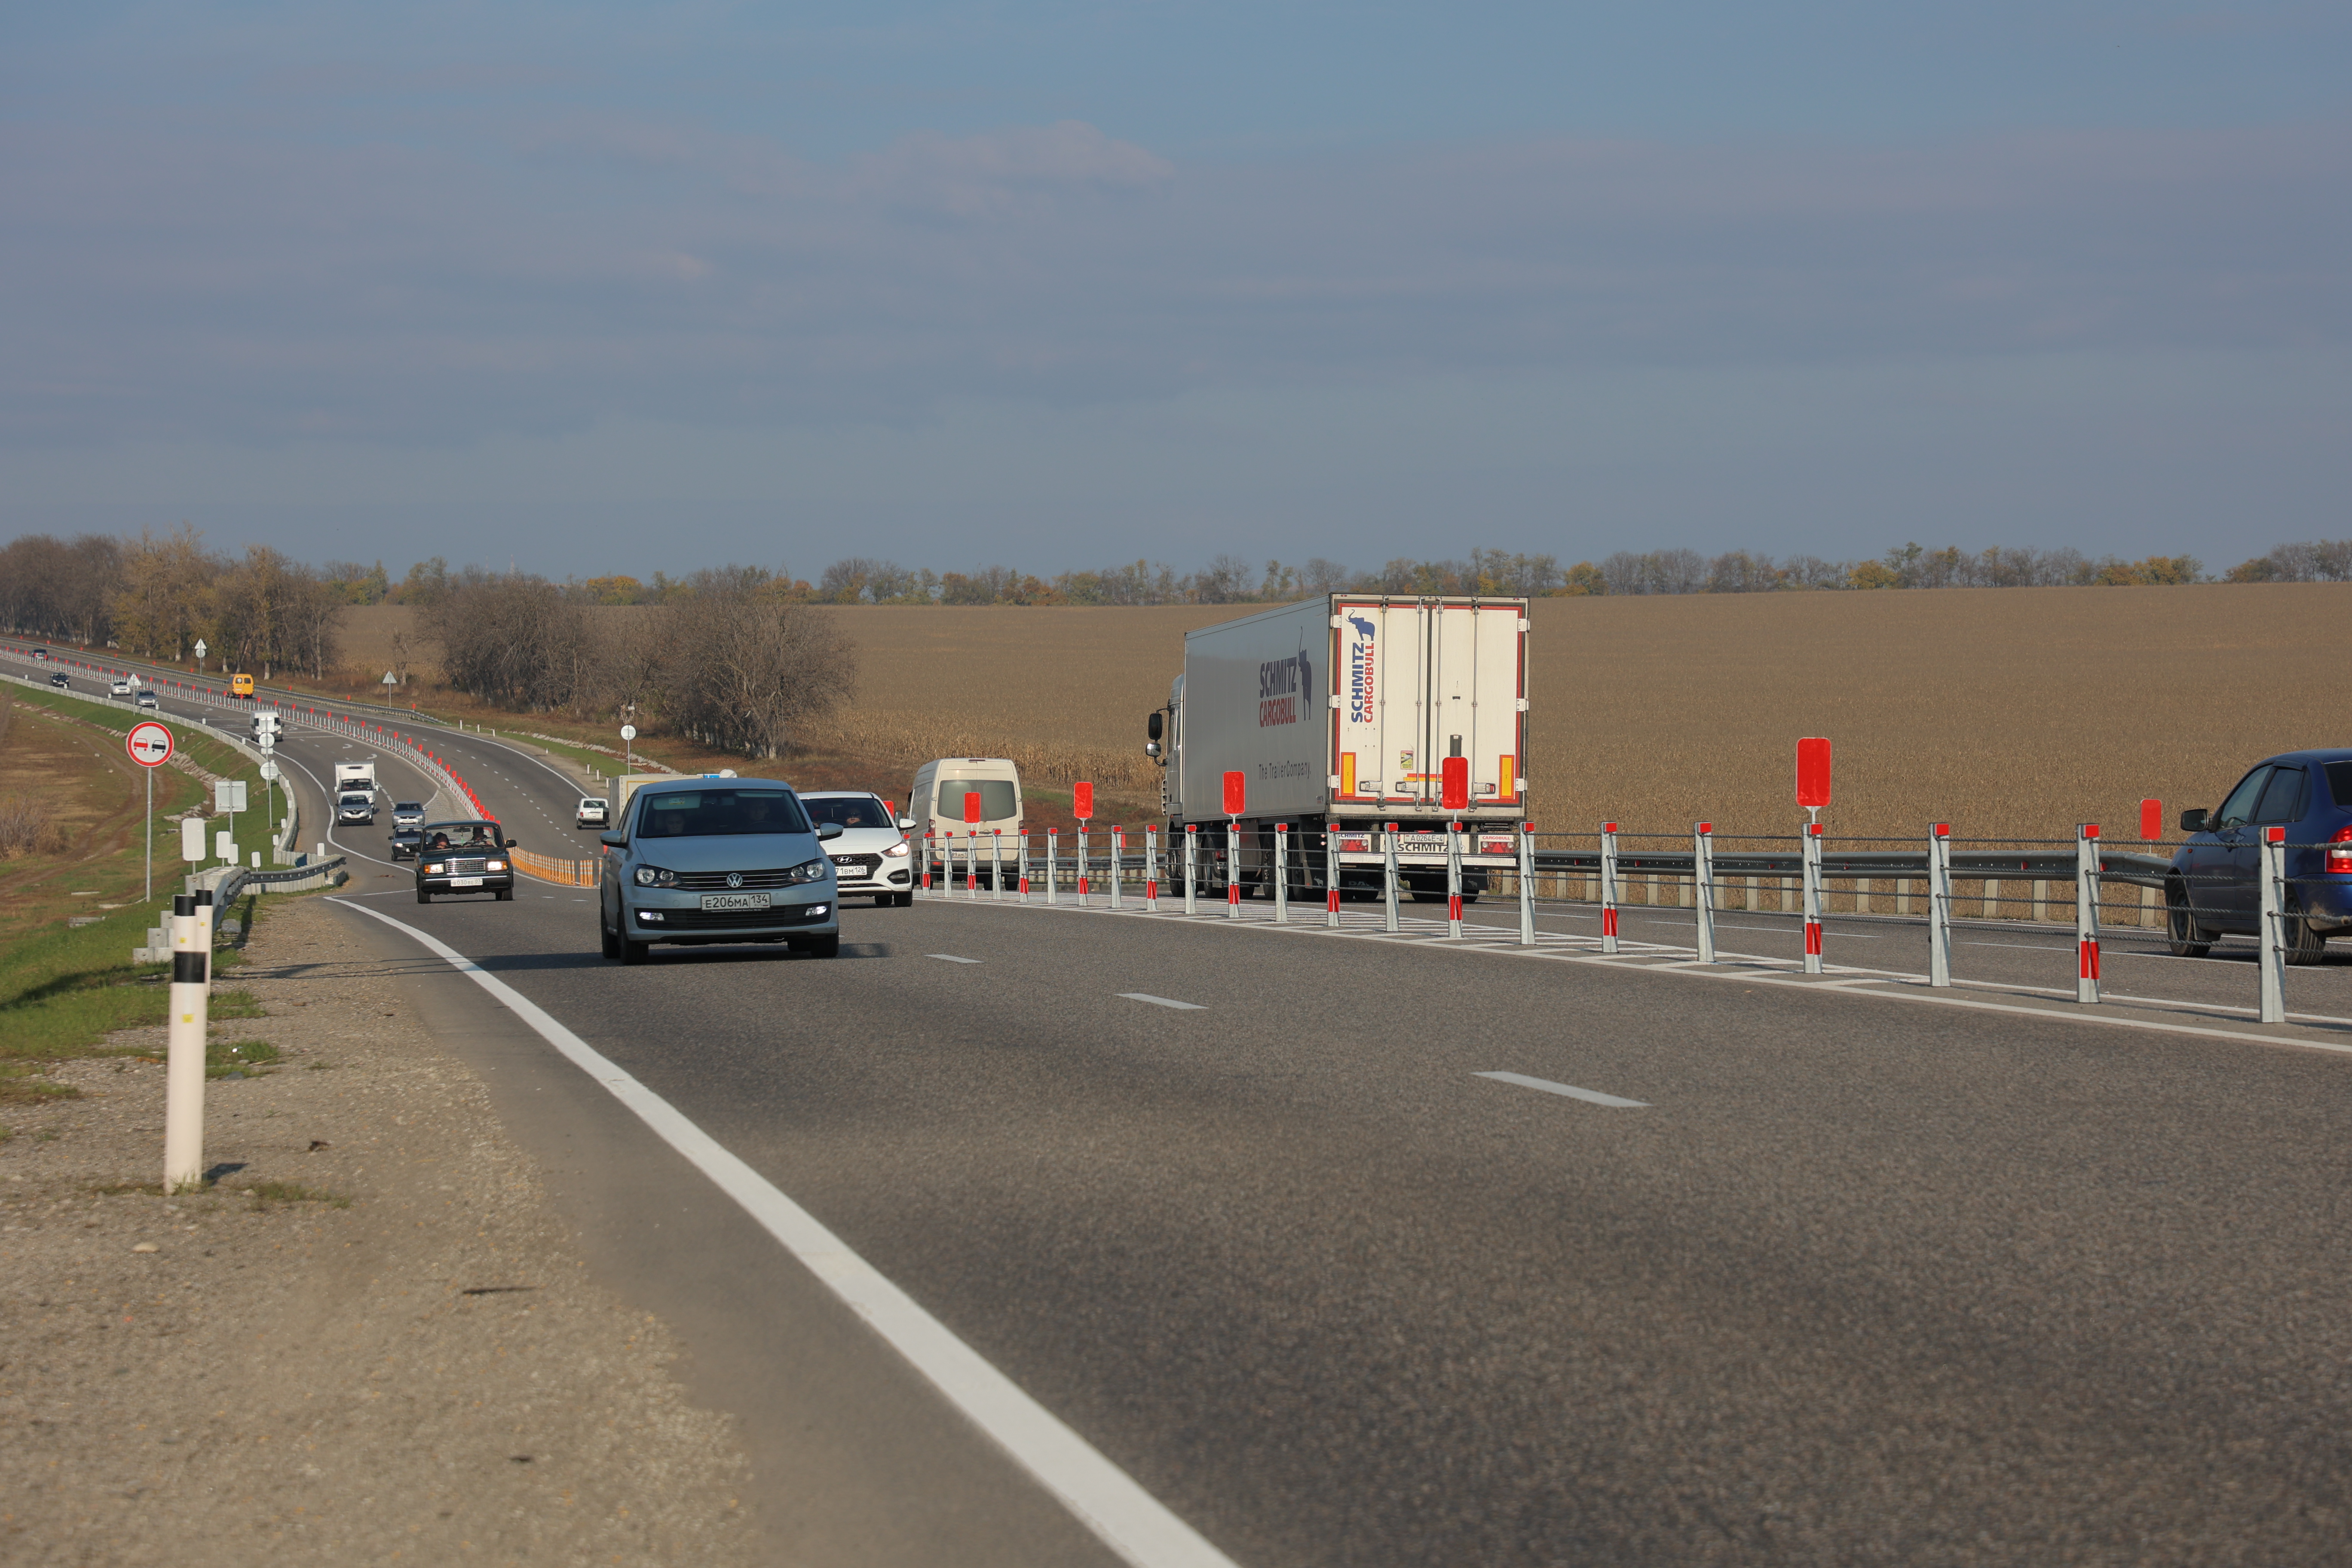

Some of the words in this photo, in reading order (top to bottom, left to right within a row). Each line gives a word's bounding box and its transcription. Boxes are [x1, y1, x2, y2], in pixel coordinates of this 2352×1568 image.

[1259, 656, 1297, 698] SCHMITZ
[1351, 642, 1364, 723] SCHMITZ
[1364, 643, 1374, 723] CARGOBULL
[1259, 696, 1296, 728] CARGOBULL
[1259, 764, 1267, 780] The
[751, 895, 768, 903] 134
